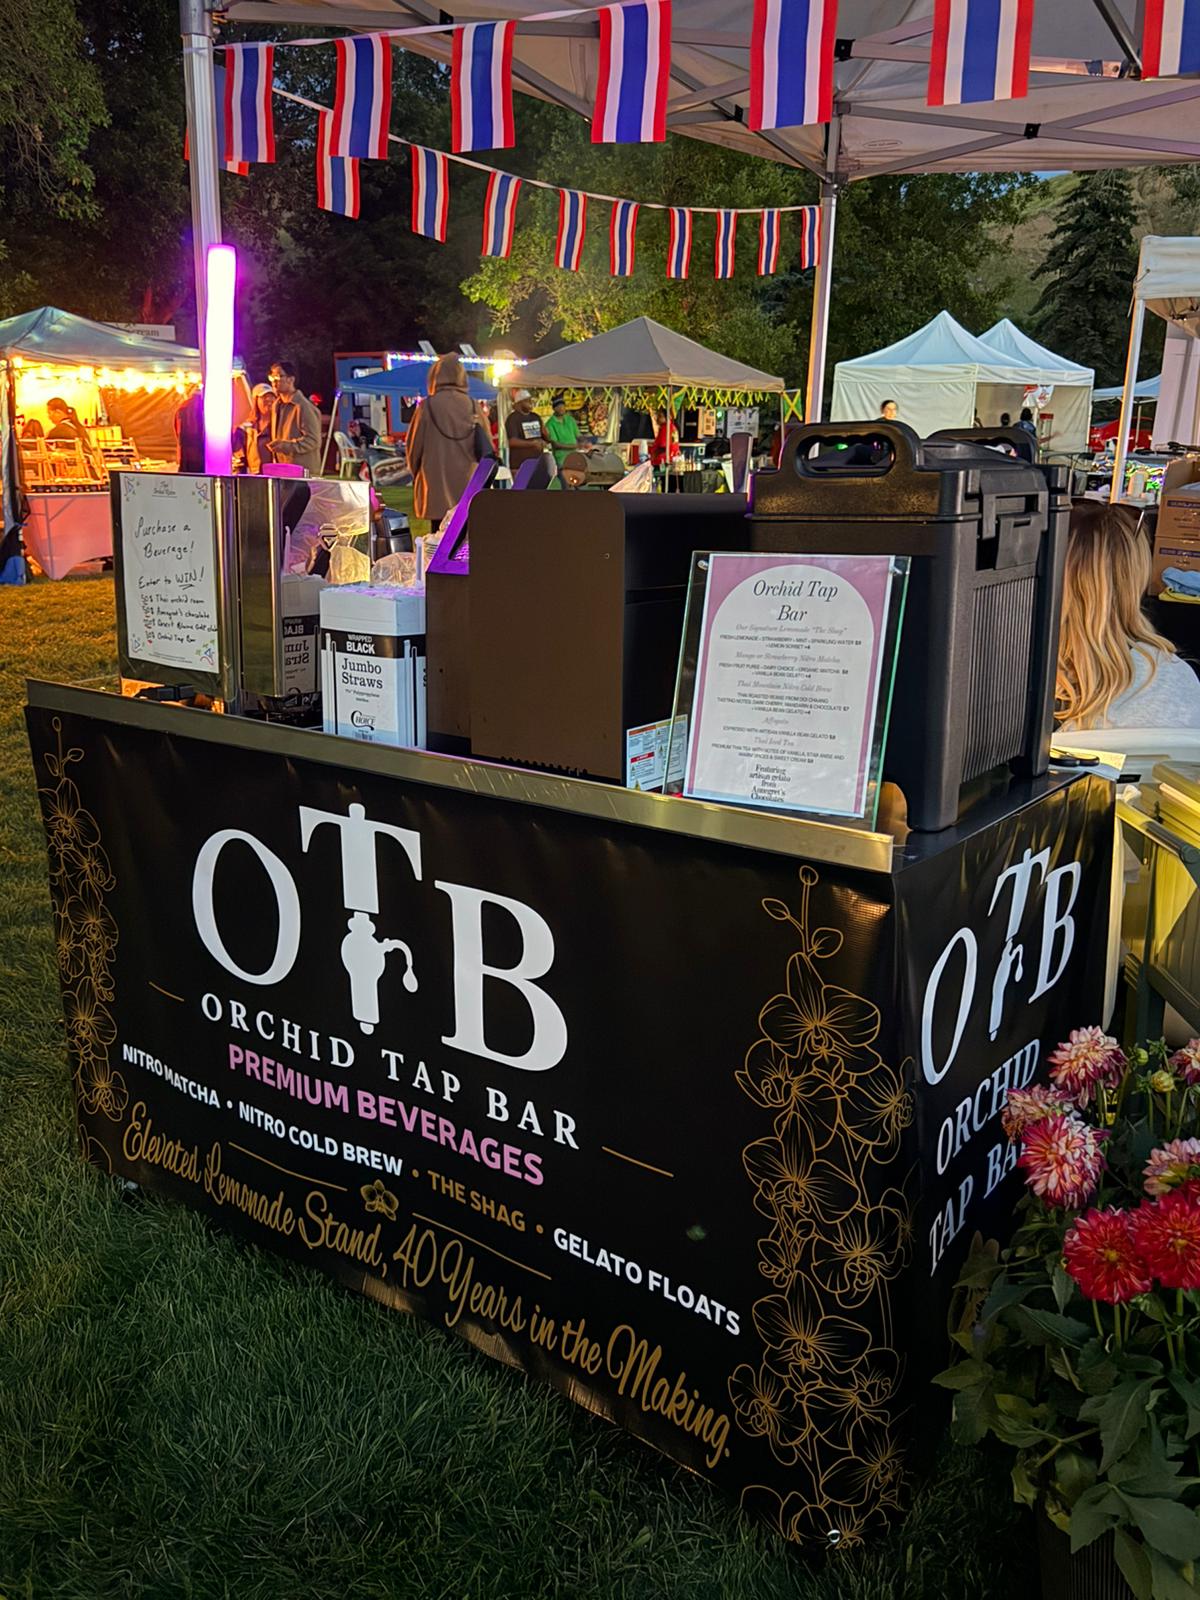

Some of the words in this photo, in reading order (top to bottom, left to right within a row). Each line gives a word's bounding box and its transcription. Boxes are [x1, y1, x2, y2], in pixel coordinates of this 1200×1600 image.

[135, 516, 176, 538] Purchase
[183, 524, 191, 532] a
[144, 541, 194, 560] Beverage!
[138, 576, 160, 589] Enter
[164, 576, 171, 584] to
[175, 566, 204, 583] WIN!
[753, 580, 803, 597] Orchid
[807, 581, 838, 602] Tap
[776, 605, 807, 621] Bar
[346, 641, 376, 654] BLACK
[348, 634, 373, 643] WRAPPED
[342, 658, 382, 675] Jumbo
[342, 671, 383, 689] Straws
[351, 710, 376, 731] CHOICE
[749, 772, 770, 780] artisan
[771, 774, 791, 782] gelato
[755, 763, 786, 775] Featuring
[192, 803, 568, 1072] OTB
[921, 846, 1082, 1086] OTB
[201, 993, 355, 1068] ORCHID
[381, 1049, 461, 1102] TAP
[486, 1087, 579, 1150] BAR
[229, 1043, 350, 1113] PREMIUM
[357, 1090, 544, 1186] BEVERAGES
[936, 1038, 1041, 1176] ORCHID
[123, 1043, 163, 1077] NITRO
[164, 1064, 221, 1109] MATCHA
[239, 1101, 286, 1139] NITRO
[288, 1126, 338, 1157] COLD
[342, 1142, 403, 1176] BREW
[427, 1170, 466, 1204] THE
[470, 1190, 526, 1232] SHAG
[553, 1227, 643, 1285] GELATO
[648, 1269, 741, 1336] FLOATS
[929, 1174, 974, 1278] TAP
[983, 1139, 1027, 1200] BA
[123, 1101, 201, 1183] Elevated
[204, 1142, 296, 1236] Lemonade
[299, 1190, 388, 1278] Stand,
[393, 1223, 437, 1289] 40
[440, 1239, 527, 1327] Years
[529, 1304, 558, 1350] in
[562, 1319, 603, 1375] the
[606, 1324, 731, 1469] Making.
